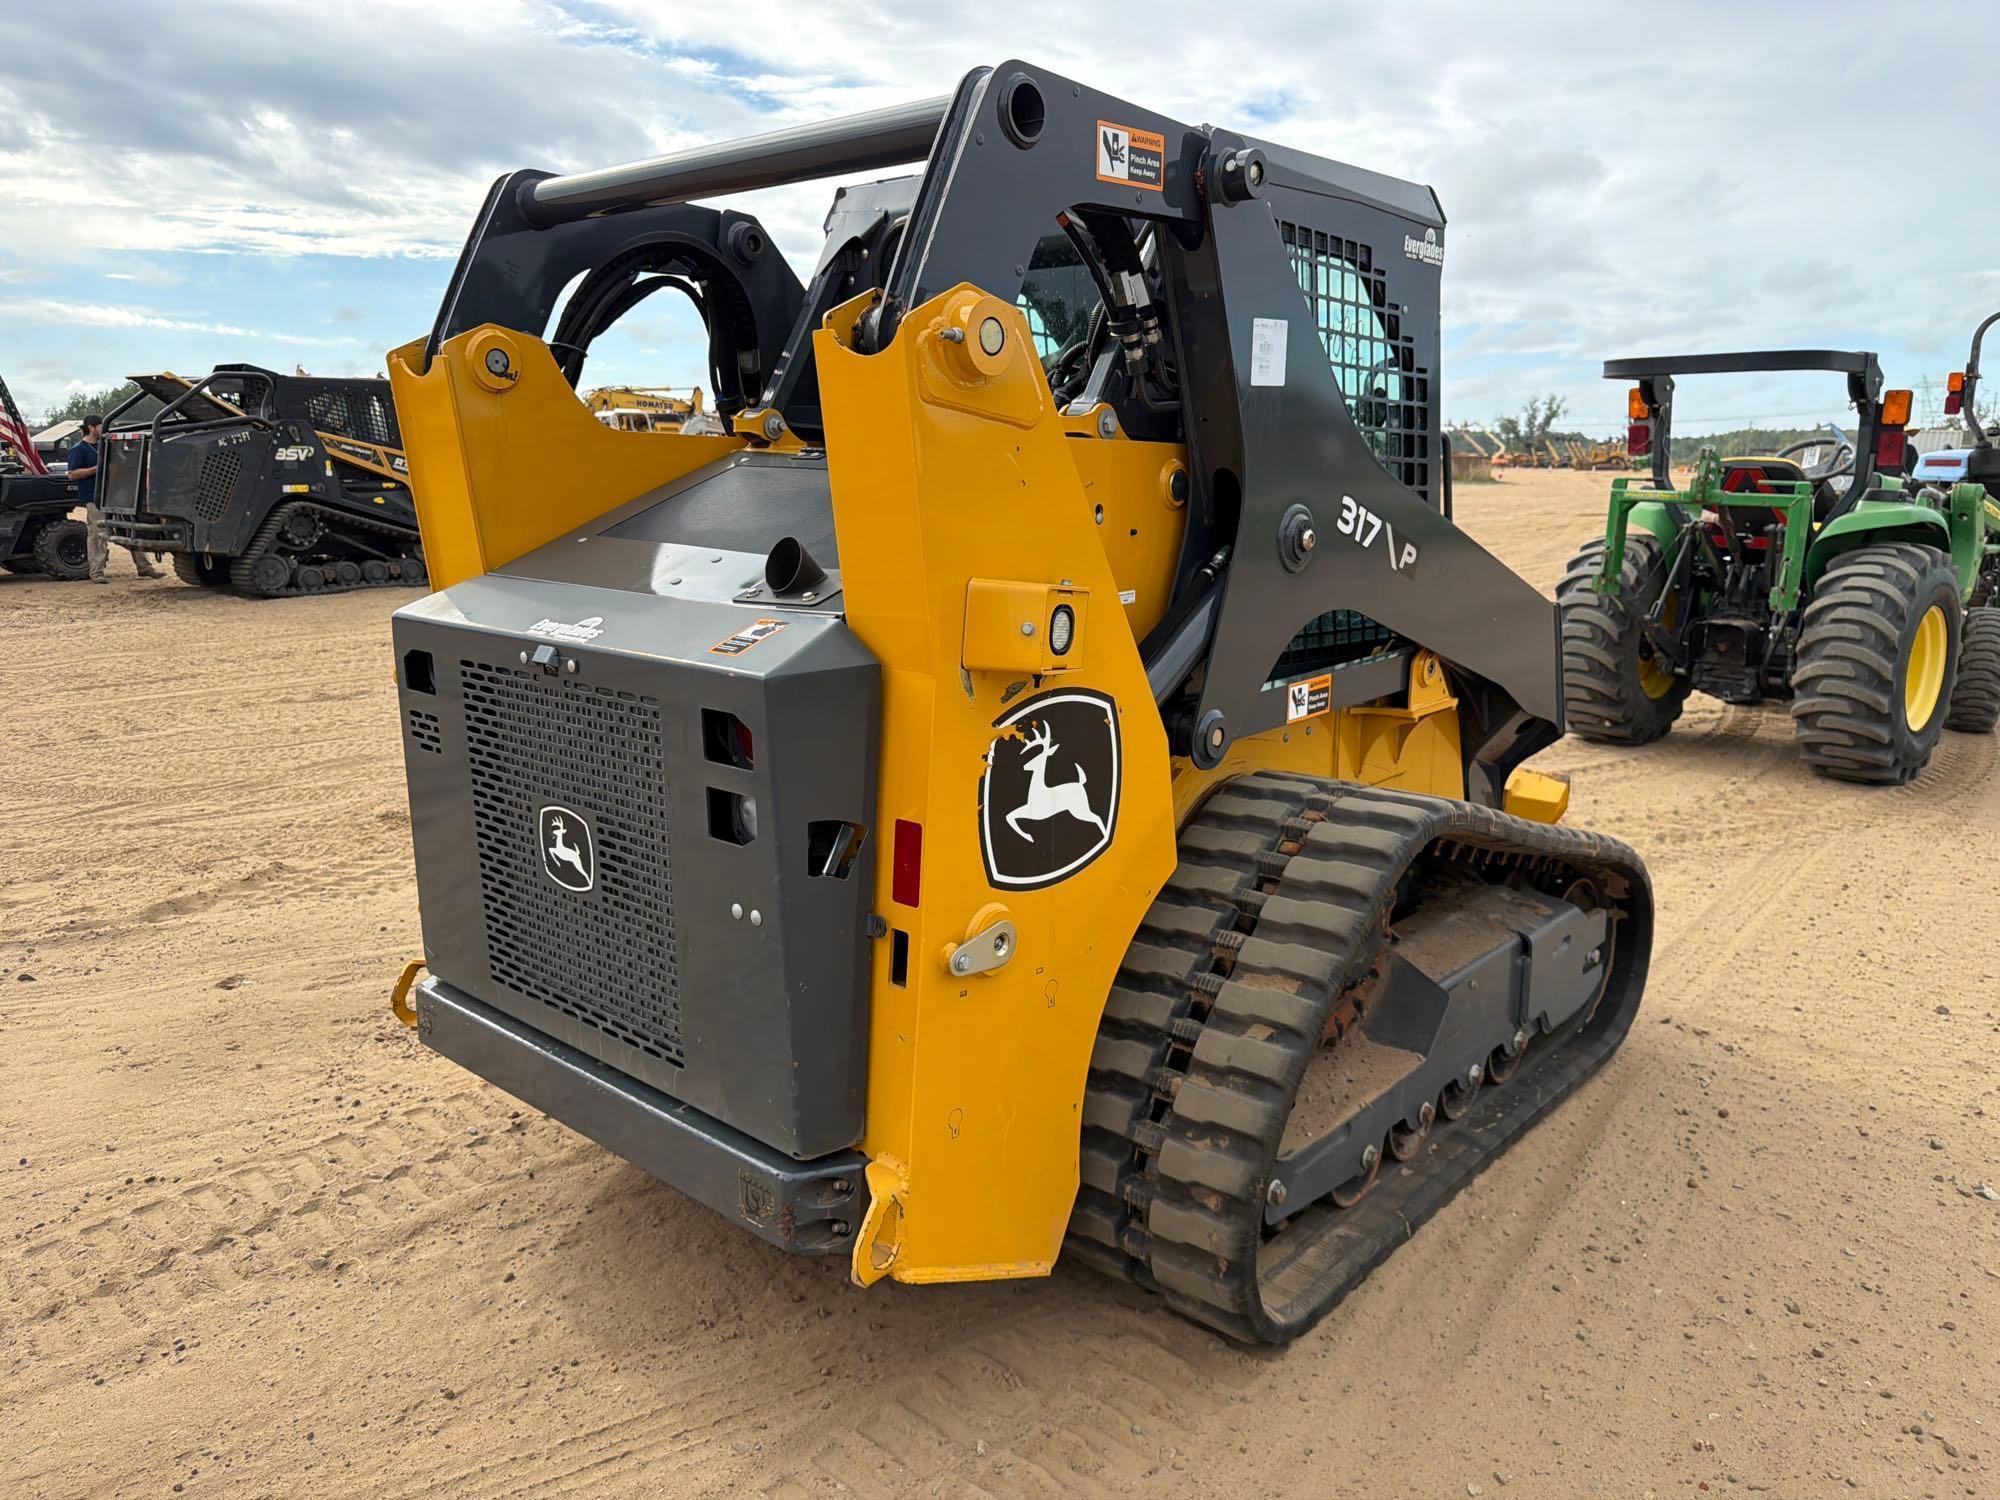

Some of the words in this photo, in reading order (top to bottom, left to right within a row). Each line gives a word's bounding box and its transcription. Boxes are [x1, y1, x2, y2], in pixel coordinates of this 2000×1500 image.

[1136, 135, 1161, 148] WARNING
[1130, 153, 1147, 165] Pinch
[1147, 157, 1160, 168] Area
[1404, 234, 1443, 260] Everglades
[636, 400, 674, 410] KOMATSU
[1336, 495, 1383, 548] 317
[529, 618, 600, 639] Everglades
